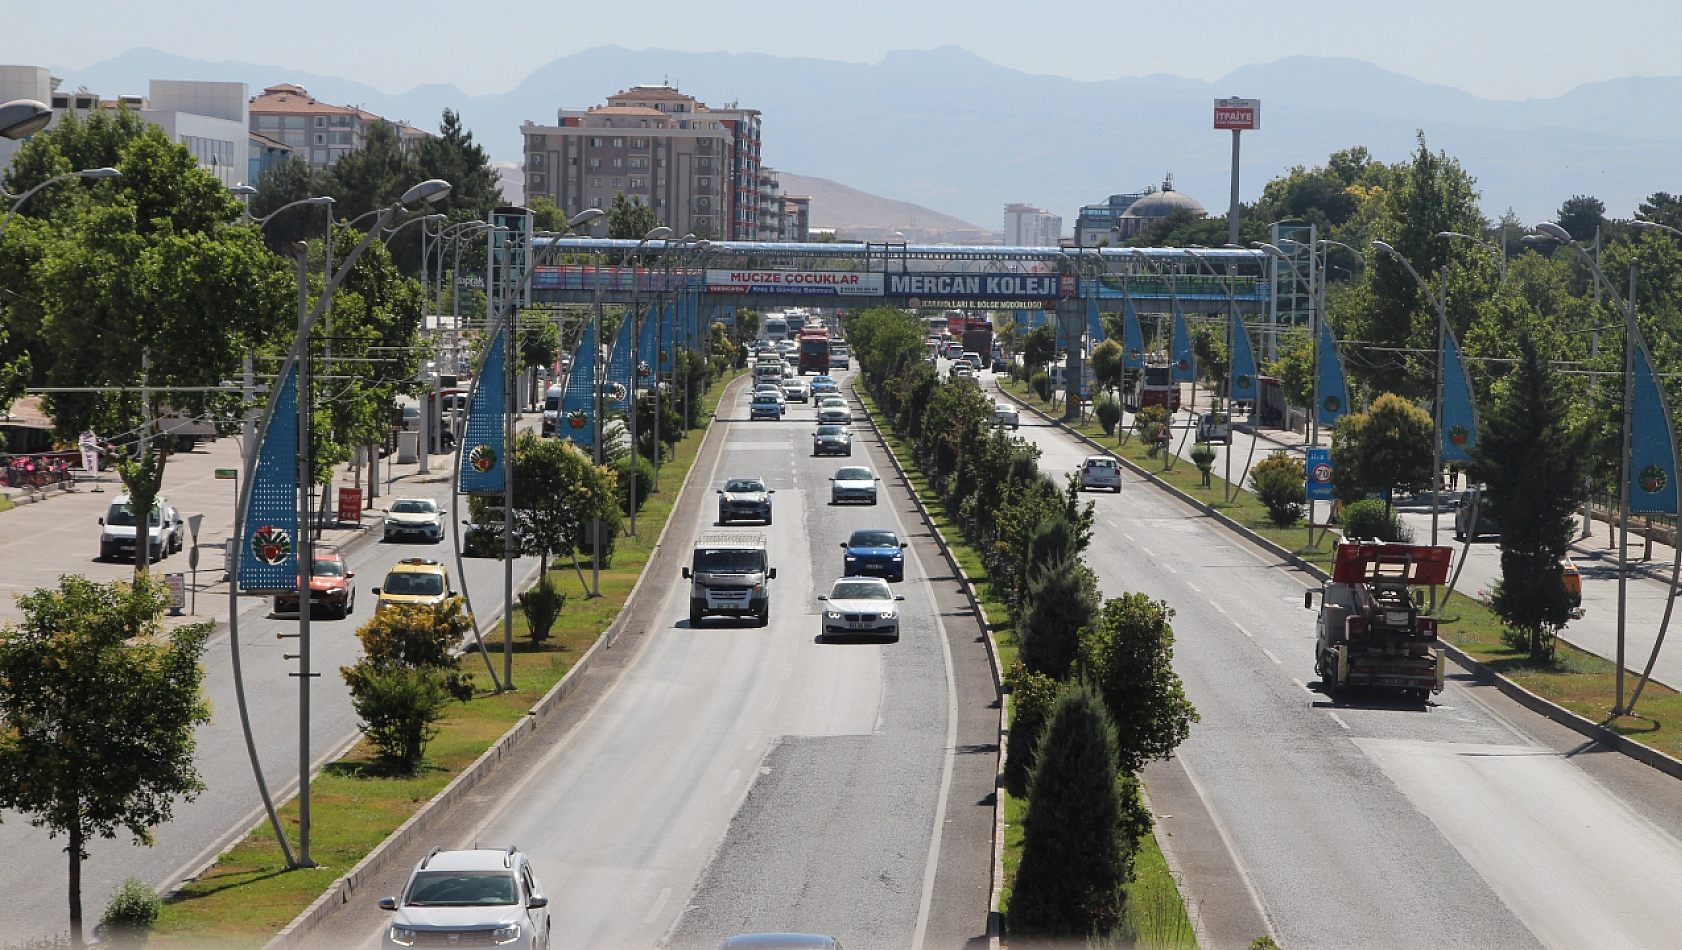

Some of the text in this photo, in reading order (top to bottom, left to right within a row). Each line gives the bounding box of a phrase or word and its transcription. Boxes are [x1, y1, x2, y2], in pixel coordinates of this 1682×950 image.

[1216, 110, 1252, 120] İTFAİYE
[457, 276, 485, 288] oprak
[785, 273, 859, 285] ÇOCUKLAR
[891, 275, 980, 294] MERCAN
[1317, 469, 1328, 478] 70
